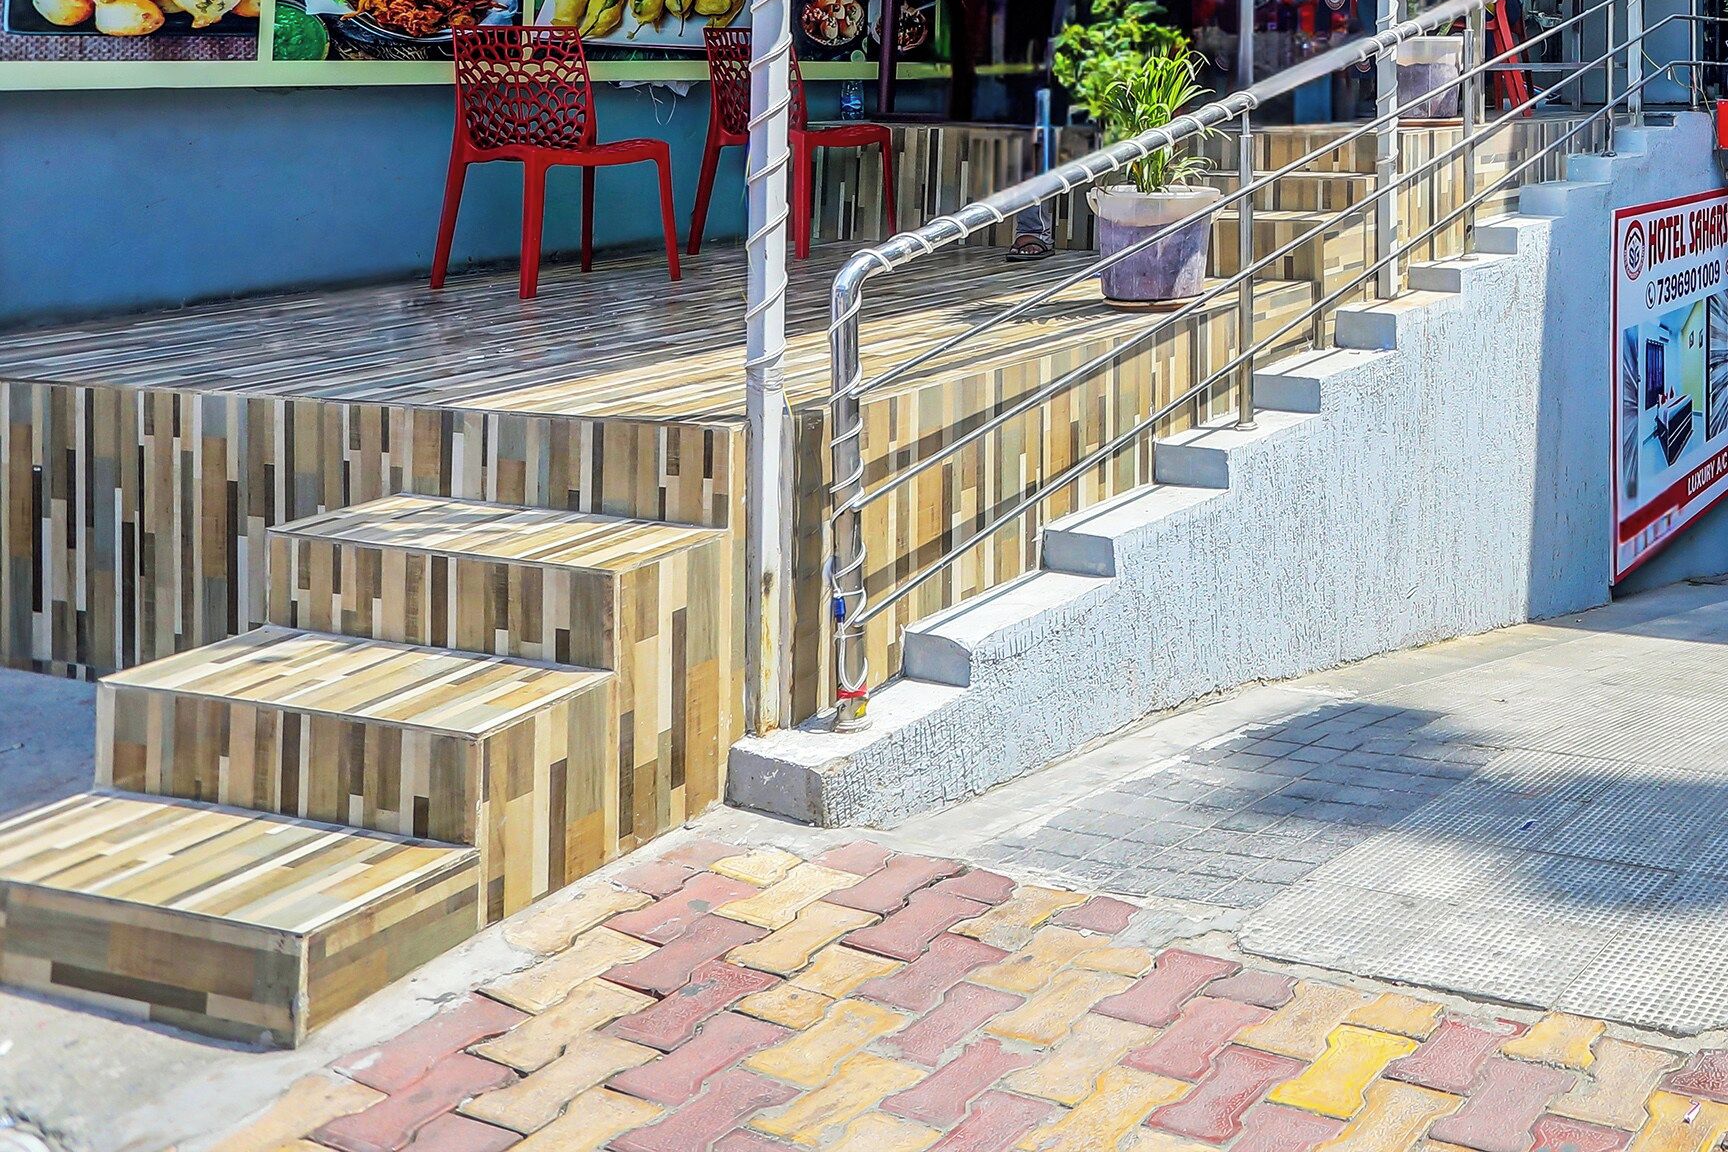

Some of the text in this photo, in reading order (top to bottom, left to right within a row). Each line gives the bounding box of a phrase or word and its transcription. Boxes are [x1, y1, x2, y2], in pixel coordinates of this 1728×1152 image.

[1648, 213, 1687, 271] HOTEL
[1657, 260, 1721, 305] 7396901009
[1687, 459, 1716, 496] LUXURY
